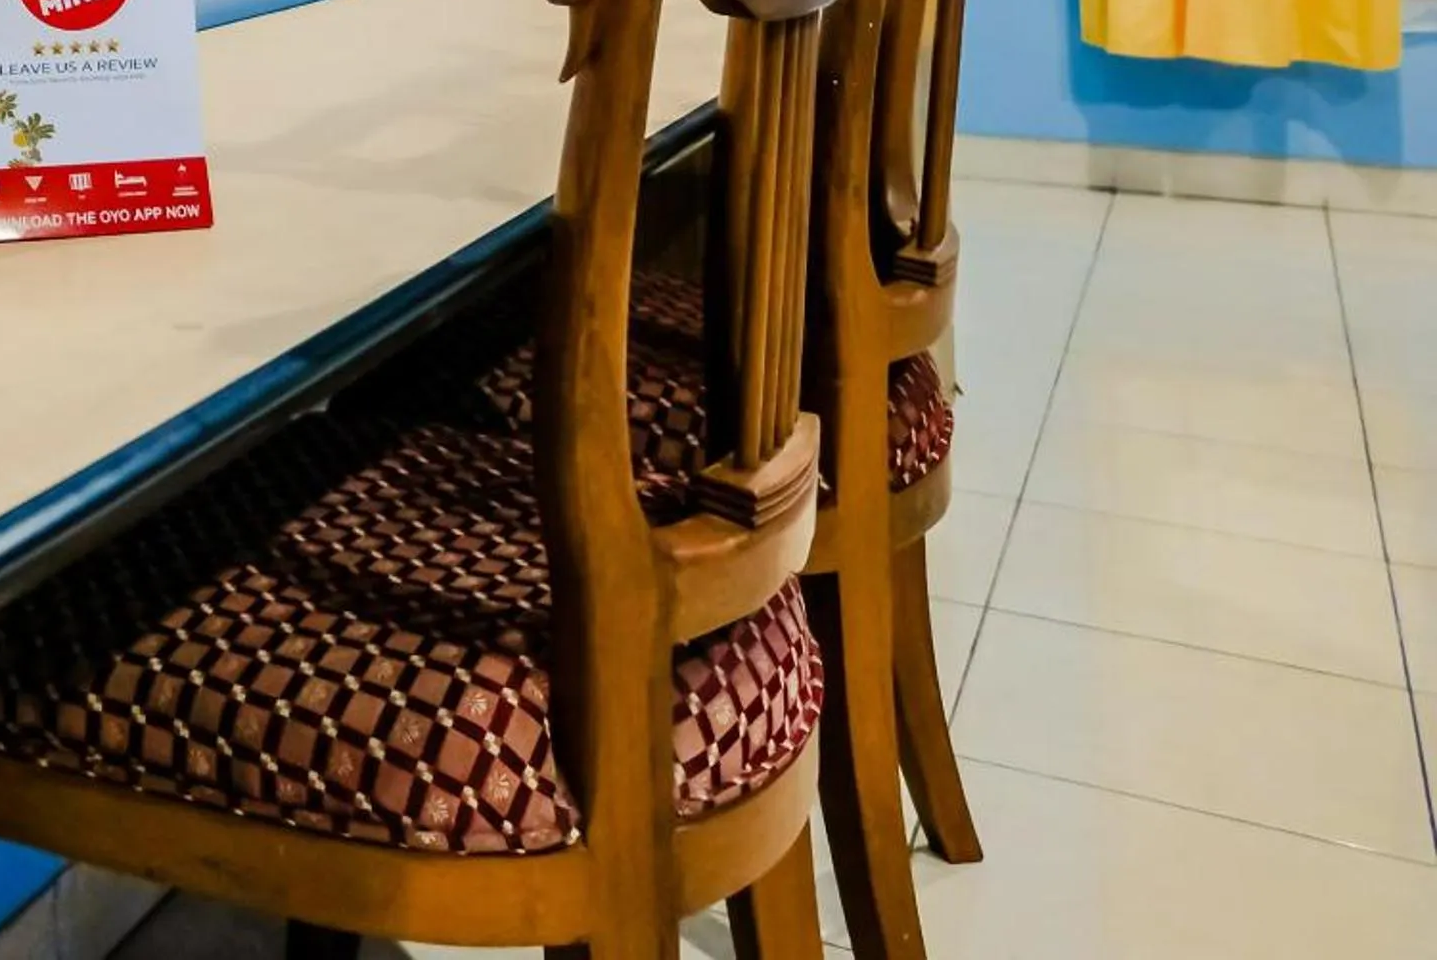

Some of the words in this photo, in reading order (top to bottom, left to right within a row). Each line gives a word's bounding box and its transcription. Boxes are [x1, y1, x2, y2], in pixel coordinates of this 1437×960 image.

[0, 61, 51, 76] LEAVE
[55, 60, 77, 74] US
[81, 61, 94, 72] A
[97, 57, 159, 72] REVIEW
[66, 211, 97, 225] THE
[99, 208, 131, 224] OYO
[133, 206, 162, 221] APP
[166, 204, 201, 218] NOW
